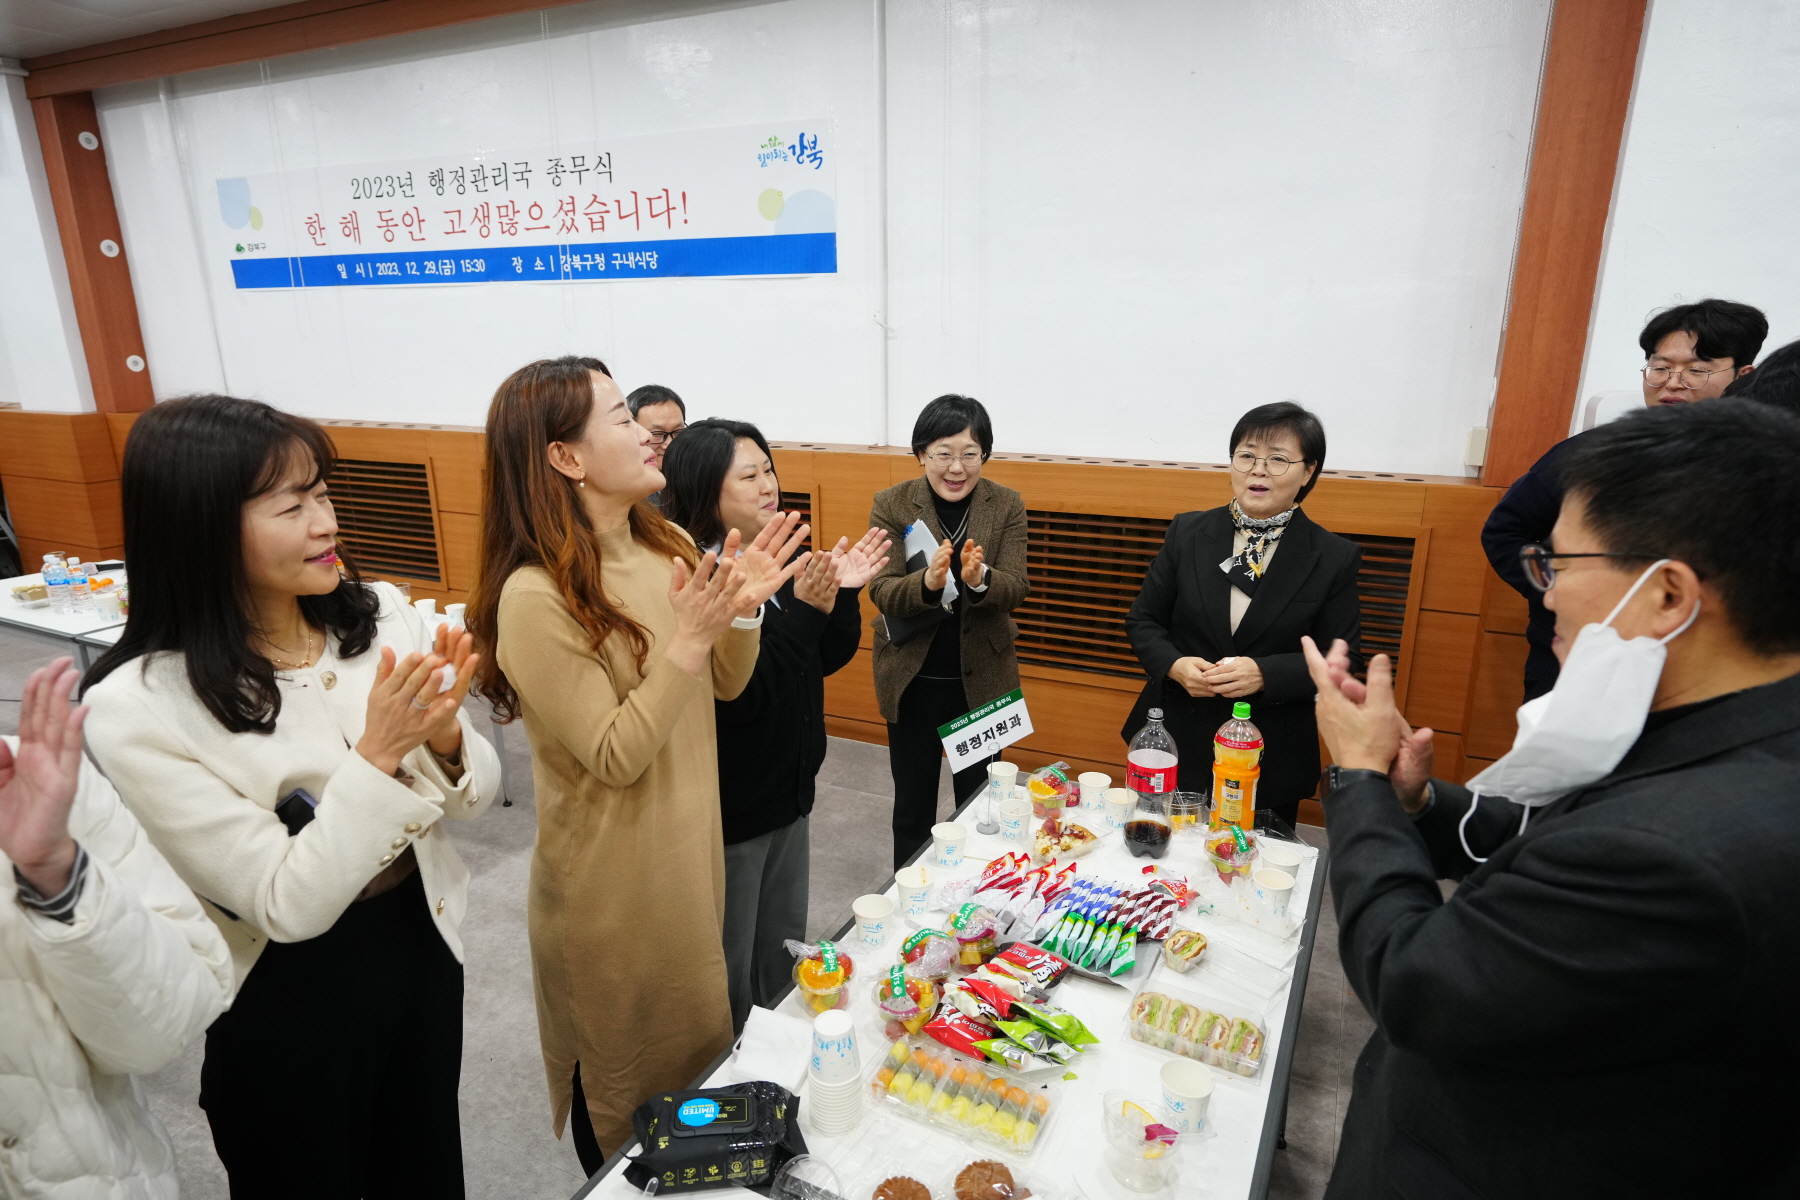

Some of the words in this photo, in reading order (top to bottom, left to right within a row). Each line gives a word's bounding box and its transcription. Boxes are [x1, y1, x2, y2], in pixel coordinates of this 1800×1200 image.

[787, 132, 823, 170] 강북
[351, 171, 415, 199] 2023년
[428, 161, 532, 196] 행정관리국
[546, 152, 612, 187] 종무식
[304, 213, 326, 246] 한
[339, 210, 361, 245] 해
[376, 206, 426, 243] 동안
[443, 188, 688, 239] 고생많으셨습니다!
[246, 243, 266, 252] 강북구
[511, 256, 523, 273] 장
[534, 256, 545, 271] 소
[560, 253, 606, 272] 강북구청
[611, 251, 658, 270] 구내식당
[337, 263, 348, 279] 일
[376, 262, 402, 276] 2023.
[405, 261, 420, 276] 12.
[424, 259, 456, 276] 29.(금)
[460, 259, 486, 273] 15:30
[950, 716, 969, 730] 2023년
[996, 696, 1012, 708] 종무식
[955, 713, 1021, 757] 행정지원과
